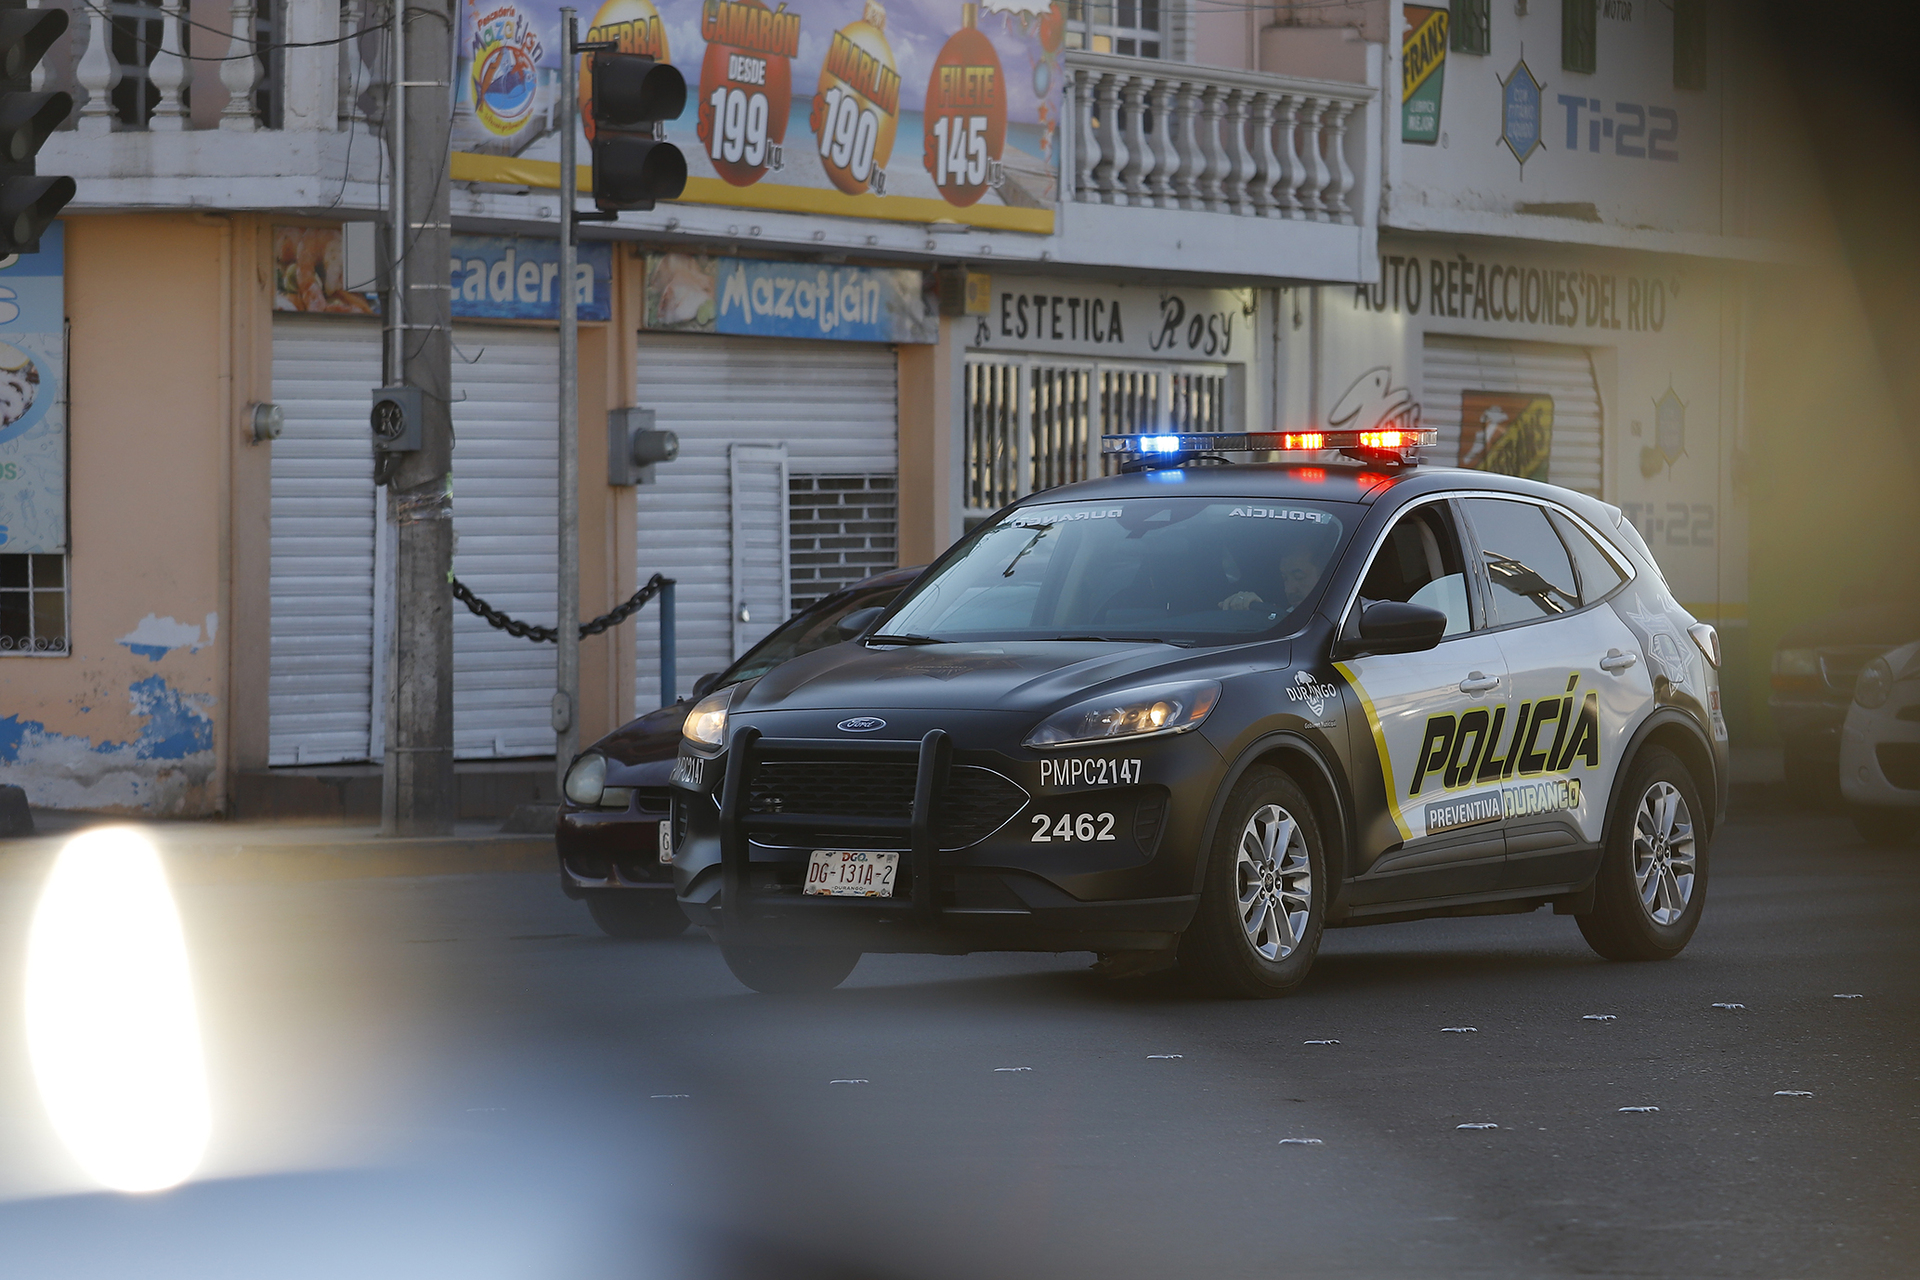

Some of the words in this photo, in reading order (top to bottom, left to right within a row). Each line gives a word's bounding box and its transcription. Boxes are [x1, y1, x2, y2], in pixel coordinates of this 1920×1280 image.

[702, 0, 800, 59] CAMARÓN
[728, 53, 767, 86] DESDE
[826, 29, 901, 117] MARLIN
[939, 65, 995, 108] FILETE
[451, 248, 594, 304] cadera
[721, 263, 881, 333] Mazatlán
[1354, 255, 1421, 314] AUTO
[1430, 259, 1578, 328] REFACCIONES
[1585, 272, 1621, 329] DEL
[1627, 277, 1666, 332] RIO
[1001, 293, 1124, 344] ESTETICA
[846, 719, 876, 728] Ford
[1408, 670, 1600, 799] POLICÍA
[1040, 758, 1142, 786] PMPC2147
[1031, 812, 1116, 842] 2462
[1430, 797, 1501, 829] PREVENTIVA
[1503, 777, 1581, 819] DURANGO
[809, 862, 893, 885] DG-131A-2
